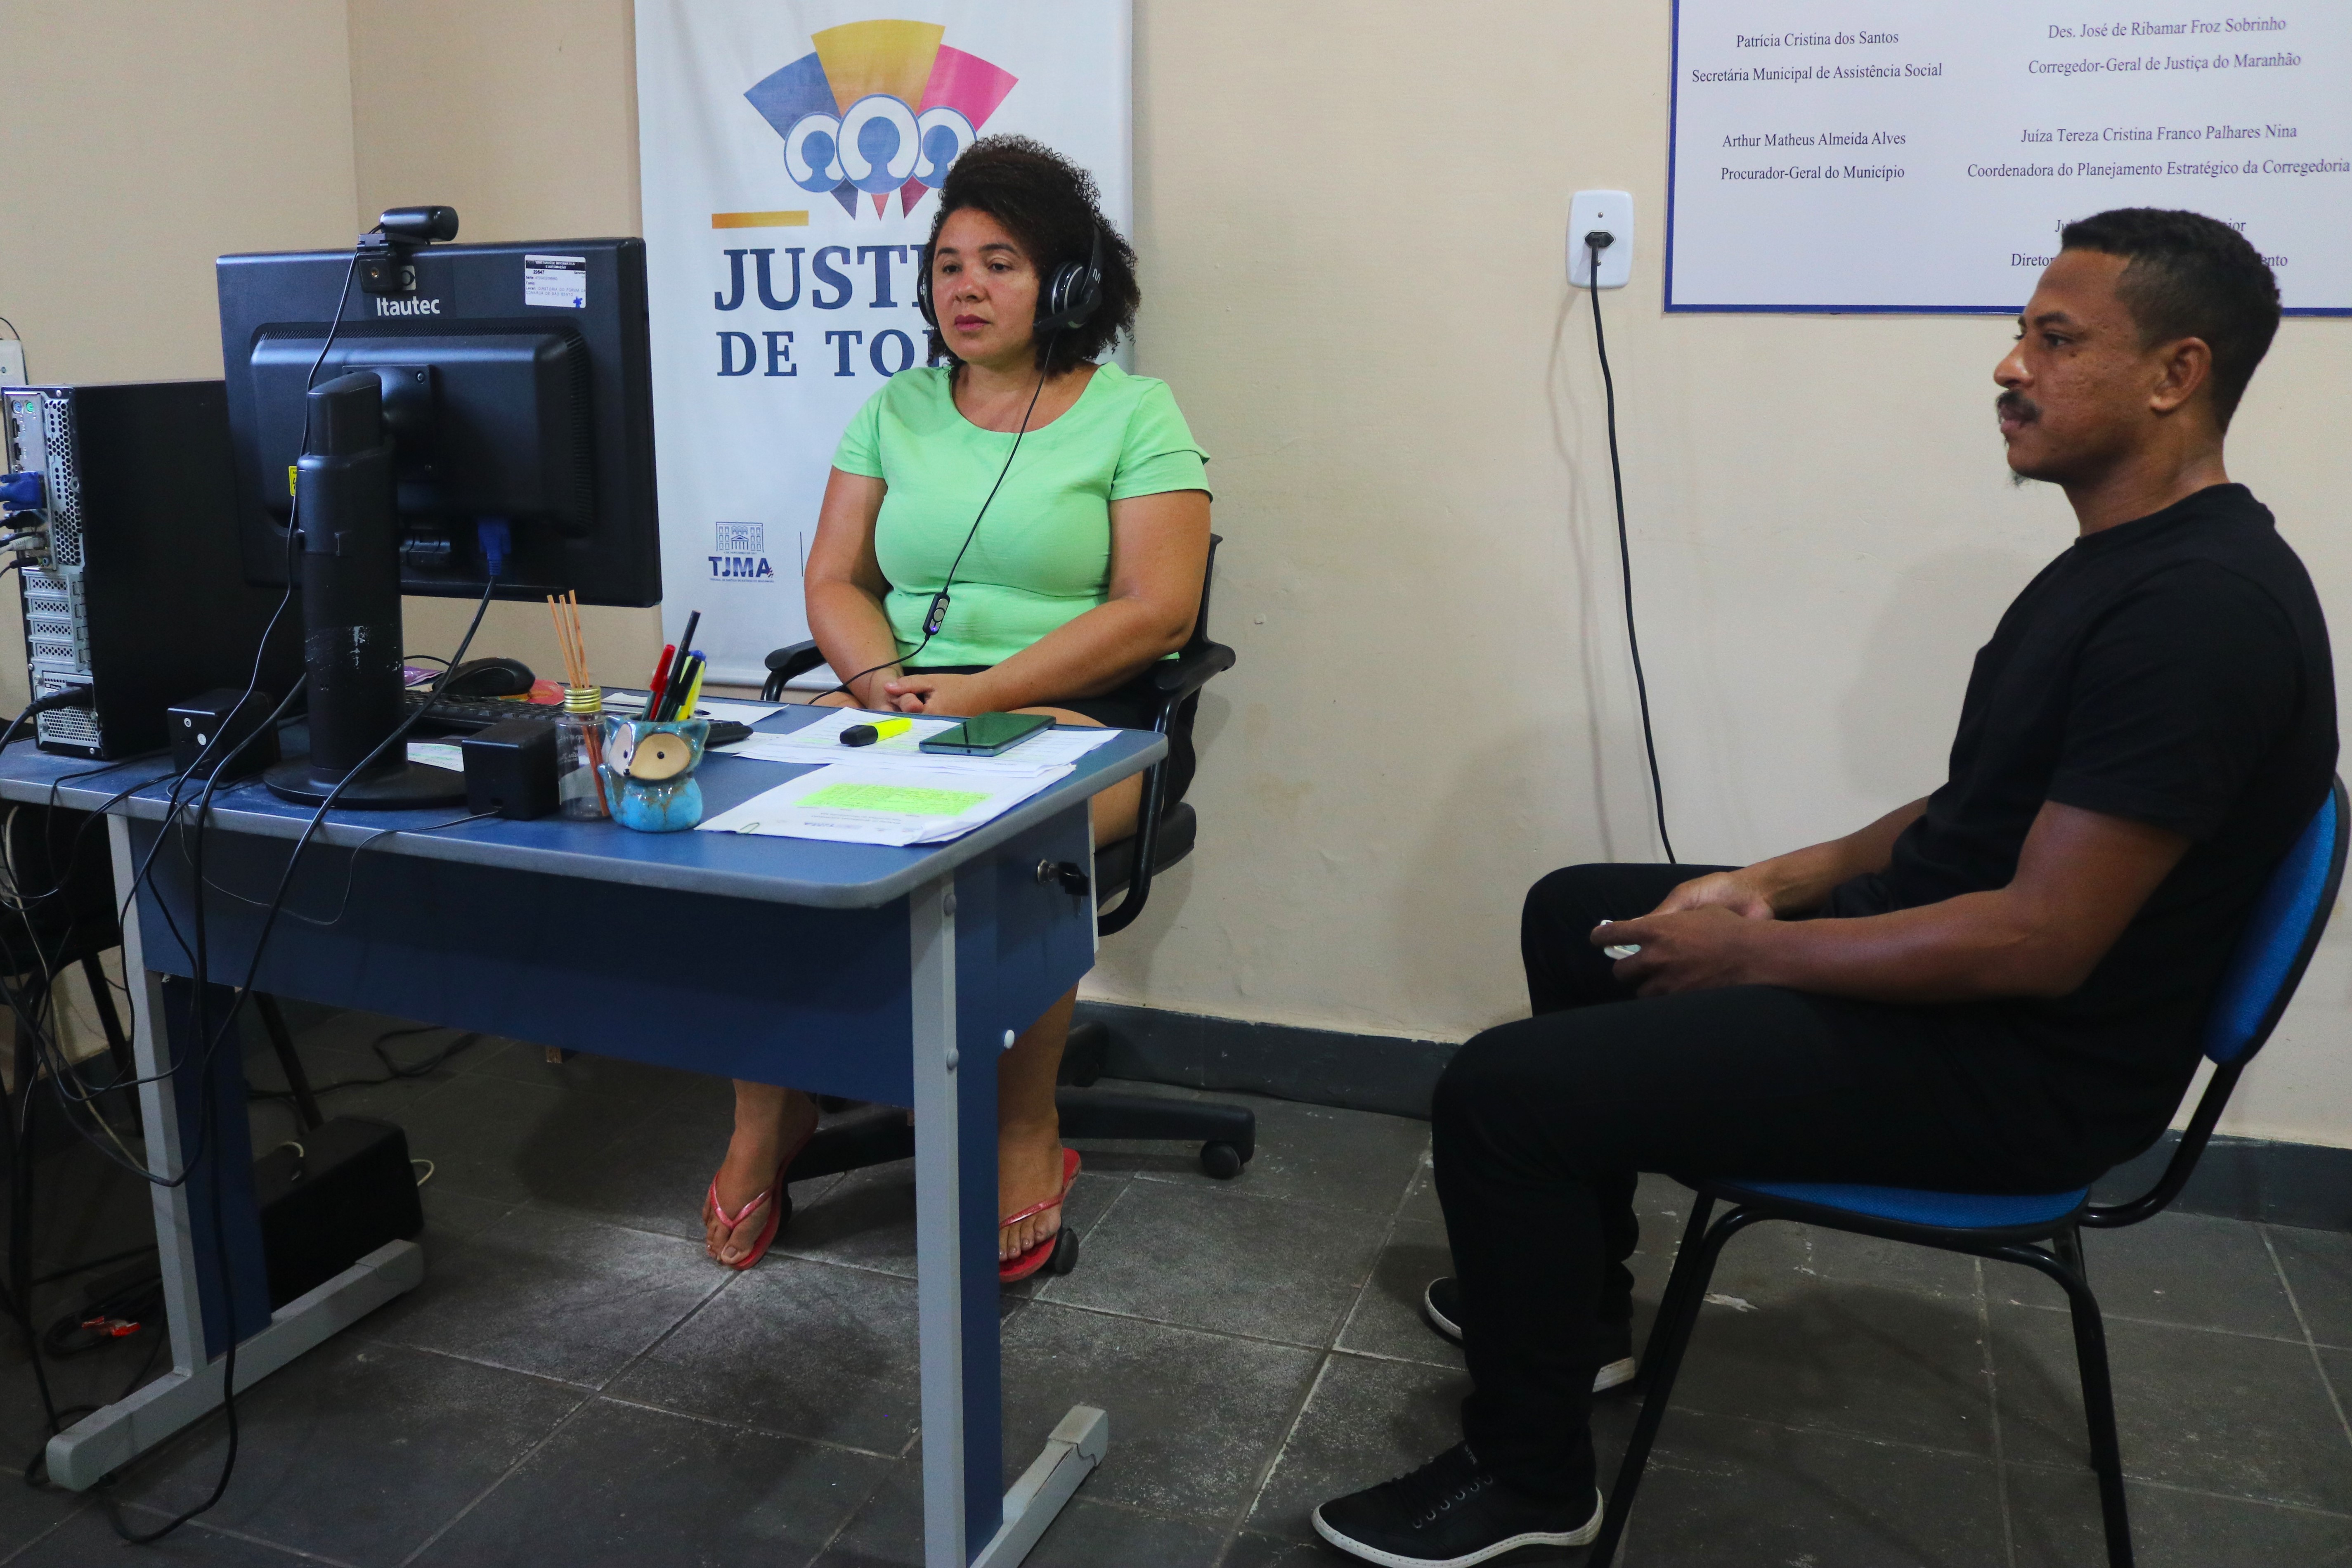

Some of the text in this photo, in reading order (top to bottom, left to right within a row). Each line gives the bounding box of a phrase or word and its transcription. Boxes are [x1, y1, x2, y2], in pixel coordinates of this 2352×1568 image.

[2049, 17, 2286, 38] Des. José de Ribamar Froz Sobrinho
[1737, 31, 1898, 47] Patrícia Cristina dos Santos
[1692, 63, 1941, 83] Secretária Municipal de Assistência Social
[2029, 53, 2301, 76] Corregedor-Geral de Justiça do Maranhão
[1723, 132, 1905, 147] Arthur Matheus Almeida Alves
[2021, 124, 2297, 142] Juíza Tereza Cristina Franco Palhares Nina
[1721, 165, 1905, 182] Procurador-Geral do Município
[1968, 158, 2350, 179] Coordenadora do Planejamento Estratégico da Corregedoria
[2261, 255, 2288, 266] ento
[376, 296, 440, 316] Itautec
[716, 331, 797, 377] DE
[708, 556, 771, 577] TJMA
